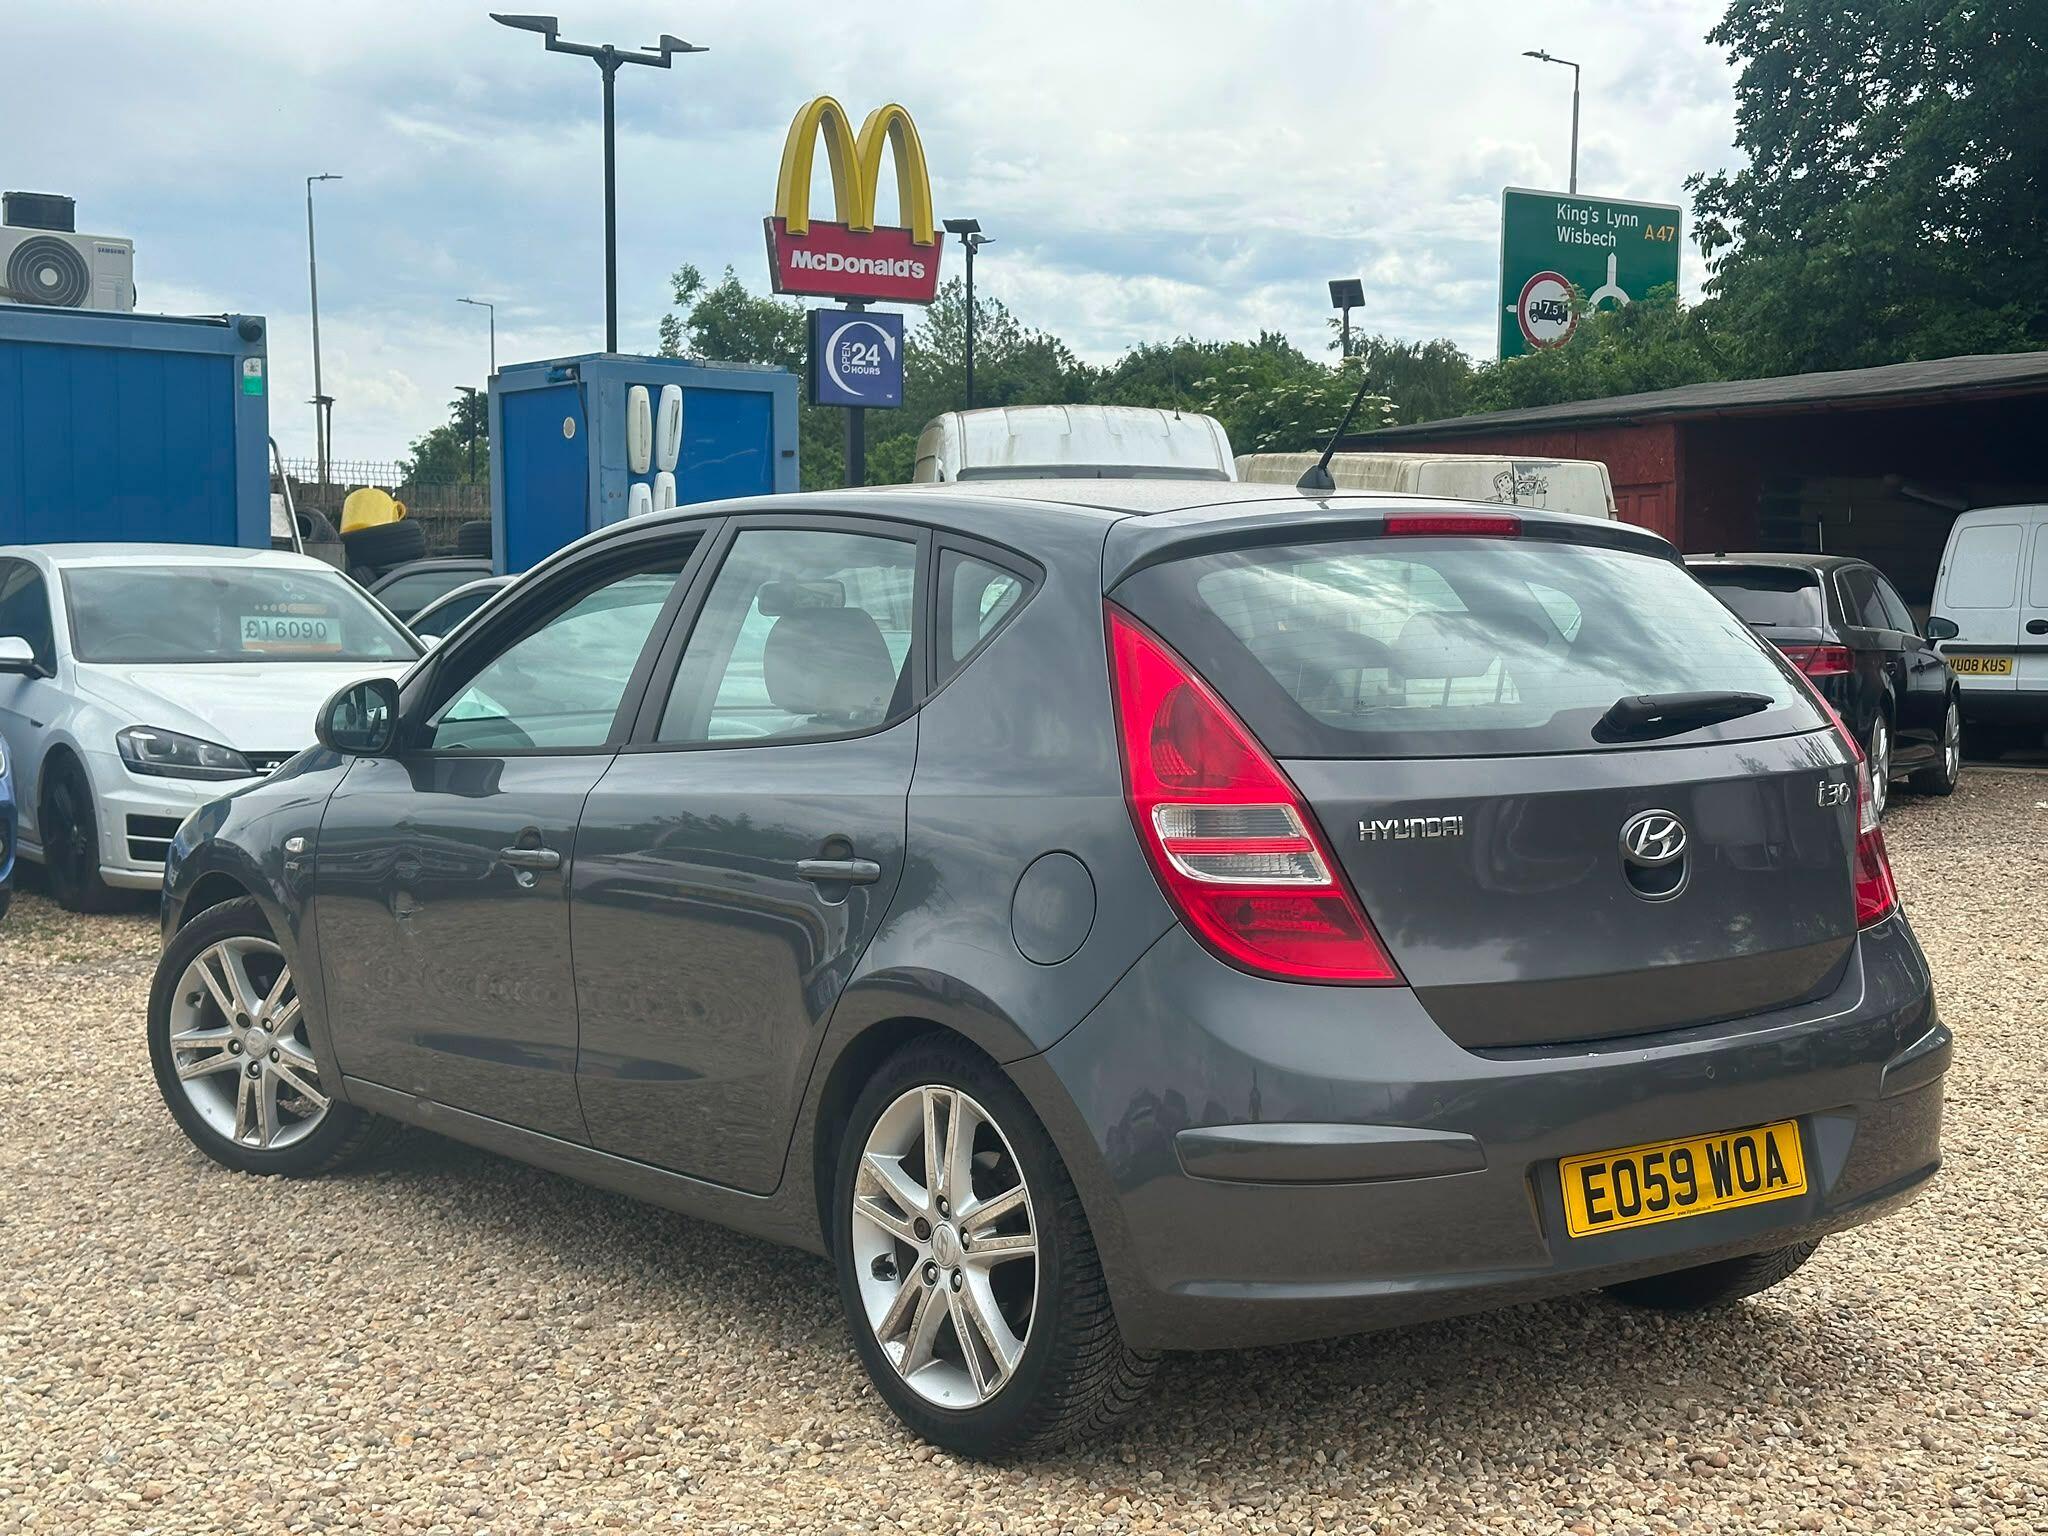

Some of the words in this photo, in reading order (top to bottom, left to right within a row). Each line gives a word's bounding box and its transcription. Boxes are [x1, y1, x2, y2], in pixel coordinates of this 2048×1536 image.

[1557, 203, 1599, 226] King's
[1606, 208, 1639, 229] Lynn
[1557, 226, 1617, 247] Wisbech
[790, 249, 925, 280] McDonald's
[841, 341, 851, 374] OPEN
[851, 342, 881, 367] 24
[851, 365, 881, 376] HOURS
[244, 619, 327, 639] £16090
[1981, 659, 2007, 672] KUS
[1817, 780, 1851, 807] i30
[1358, 815, 1464, 841] HYUNDAI
[1705, 1131, 1789, 1199] WOA
